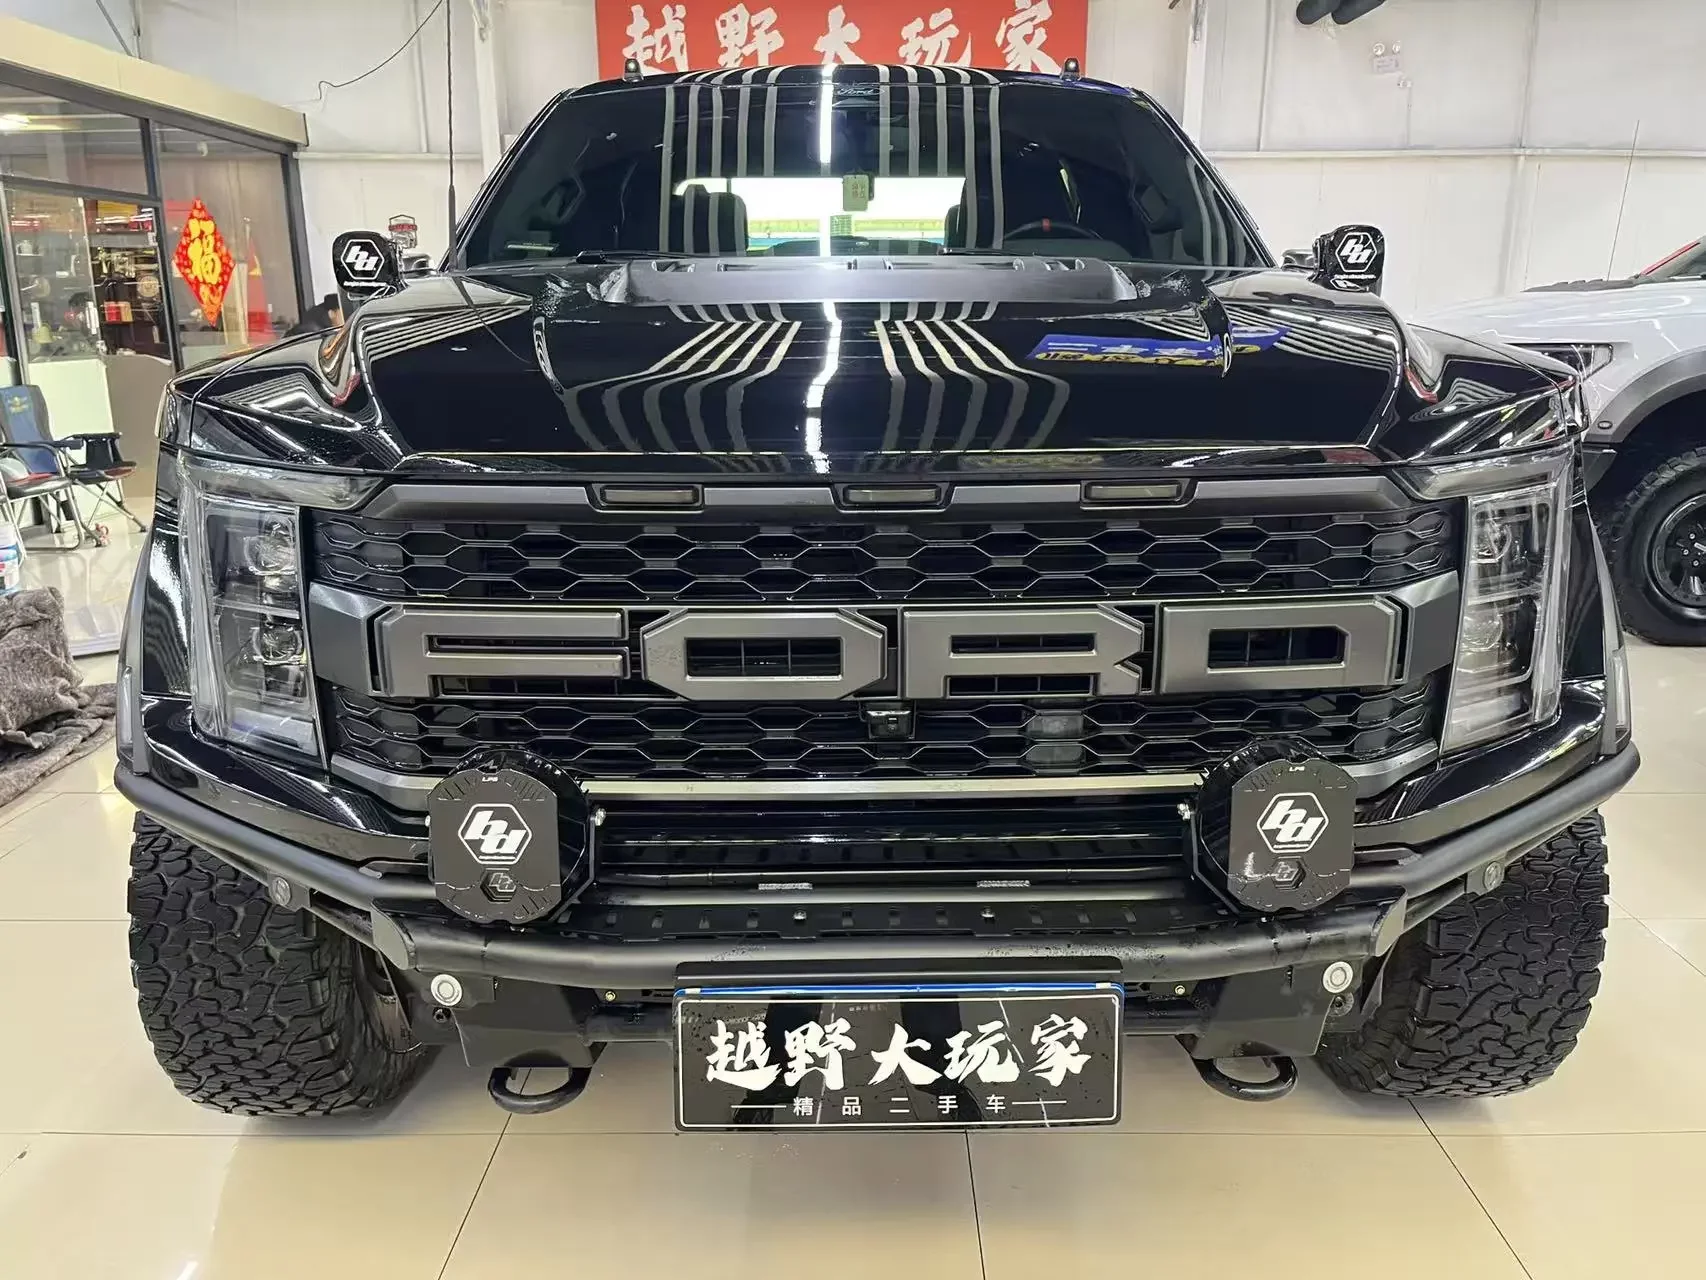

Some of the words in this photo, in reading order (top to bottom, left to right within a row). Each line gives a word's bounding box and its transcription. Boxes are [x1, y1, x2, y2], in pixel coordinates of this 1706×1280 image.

[622, 0, 1066, 76] 越野大玩家
[374, 594, 1401, 702] FORD
[706, 1013, 1092, 1091] 越野大玩家
[792, 1094, 1006, 1117] 精品二手车
